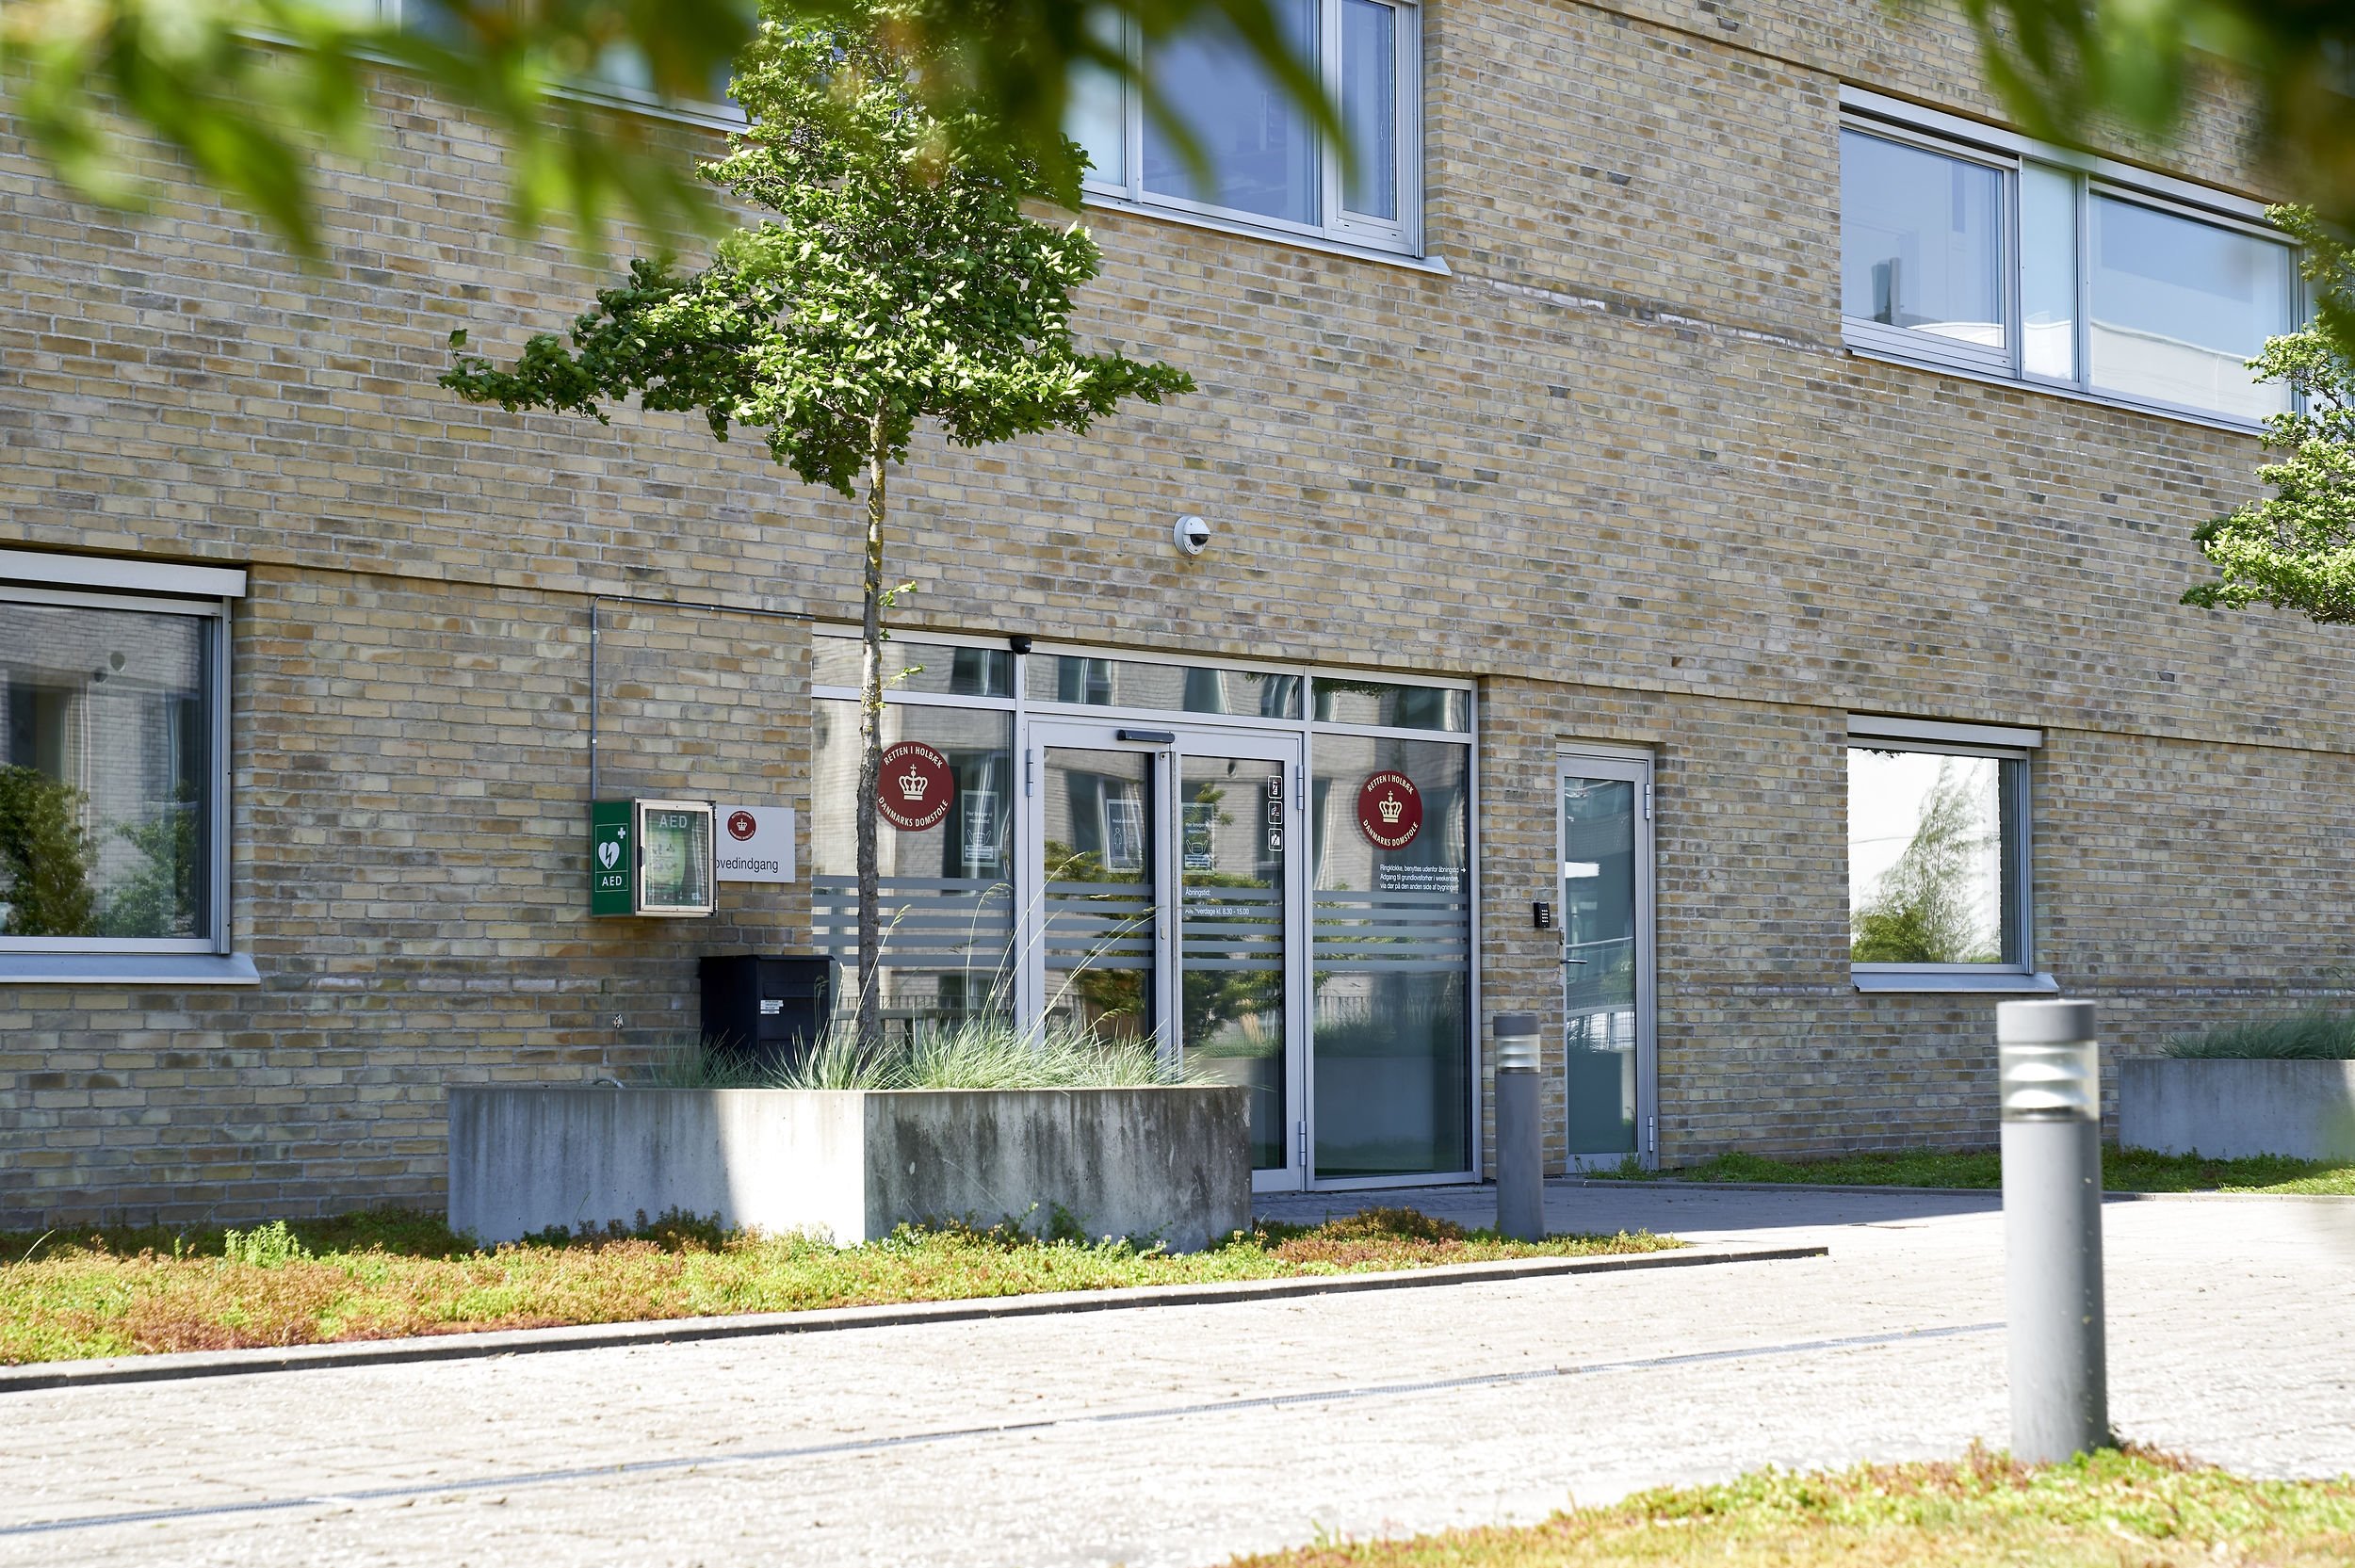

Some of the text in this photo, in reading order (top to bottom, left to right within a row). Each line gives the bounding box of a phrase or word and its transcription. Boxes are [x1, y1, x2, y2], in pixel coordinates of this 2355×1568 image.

[884, 746, 943, 769] RETTEN I HOLBÆK
[1367, 774, 1387, 792] RETTEN
[1391, 774, 1414, 795] HOLBÆK
[878, 796, 949, 827] DANMARKS DOMSTOLE
[659, 815, 688, 829] AED
[1363, 818, 1419, 847] DANMARKS DOMSTOLE
[716, 856, 778, 873] ovedindgang
[1379, 864, 1404, 872] Ringklokke,
[1404, 865, 1421, 873] benyttes
[602, 876, 623, 886] AED
[1380, 873, 1396, 881] Adgang
[1185, 886, 1210, 897] Åbningstid:
[1223, 907, 1233, 915] 8.30
